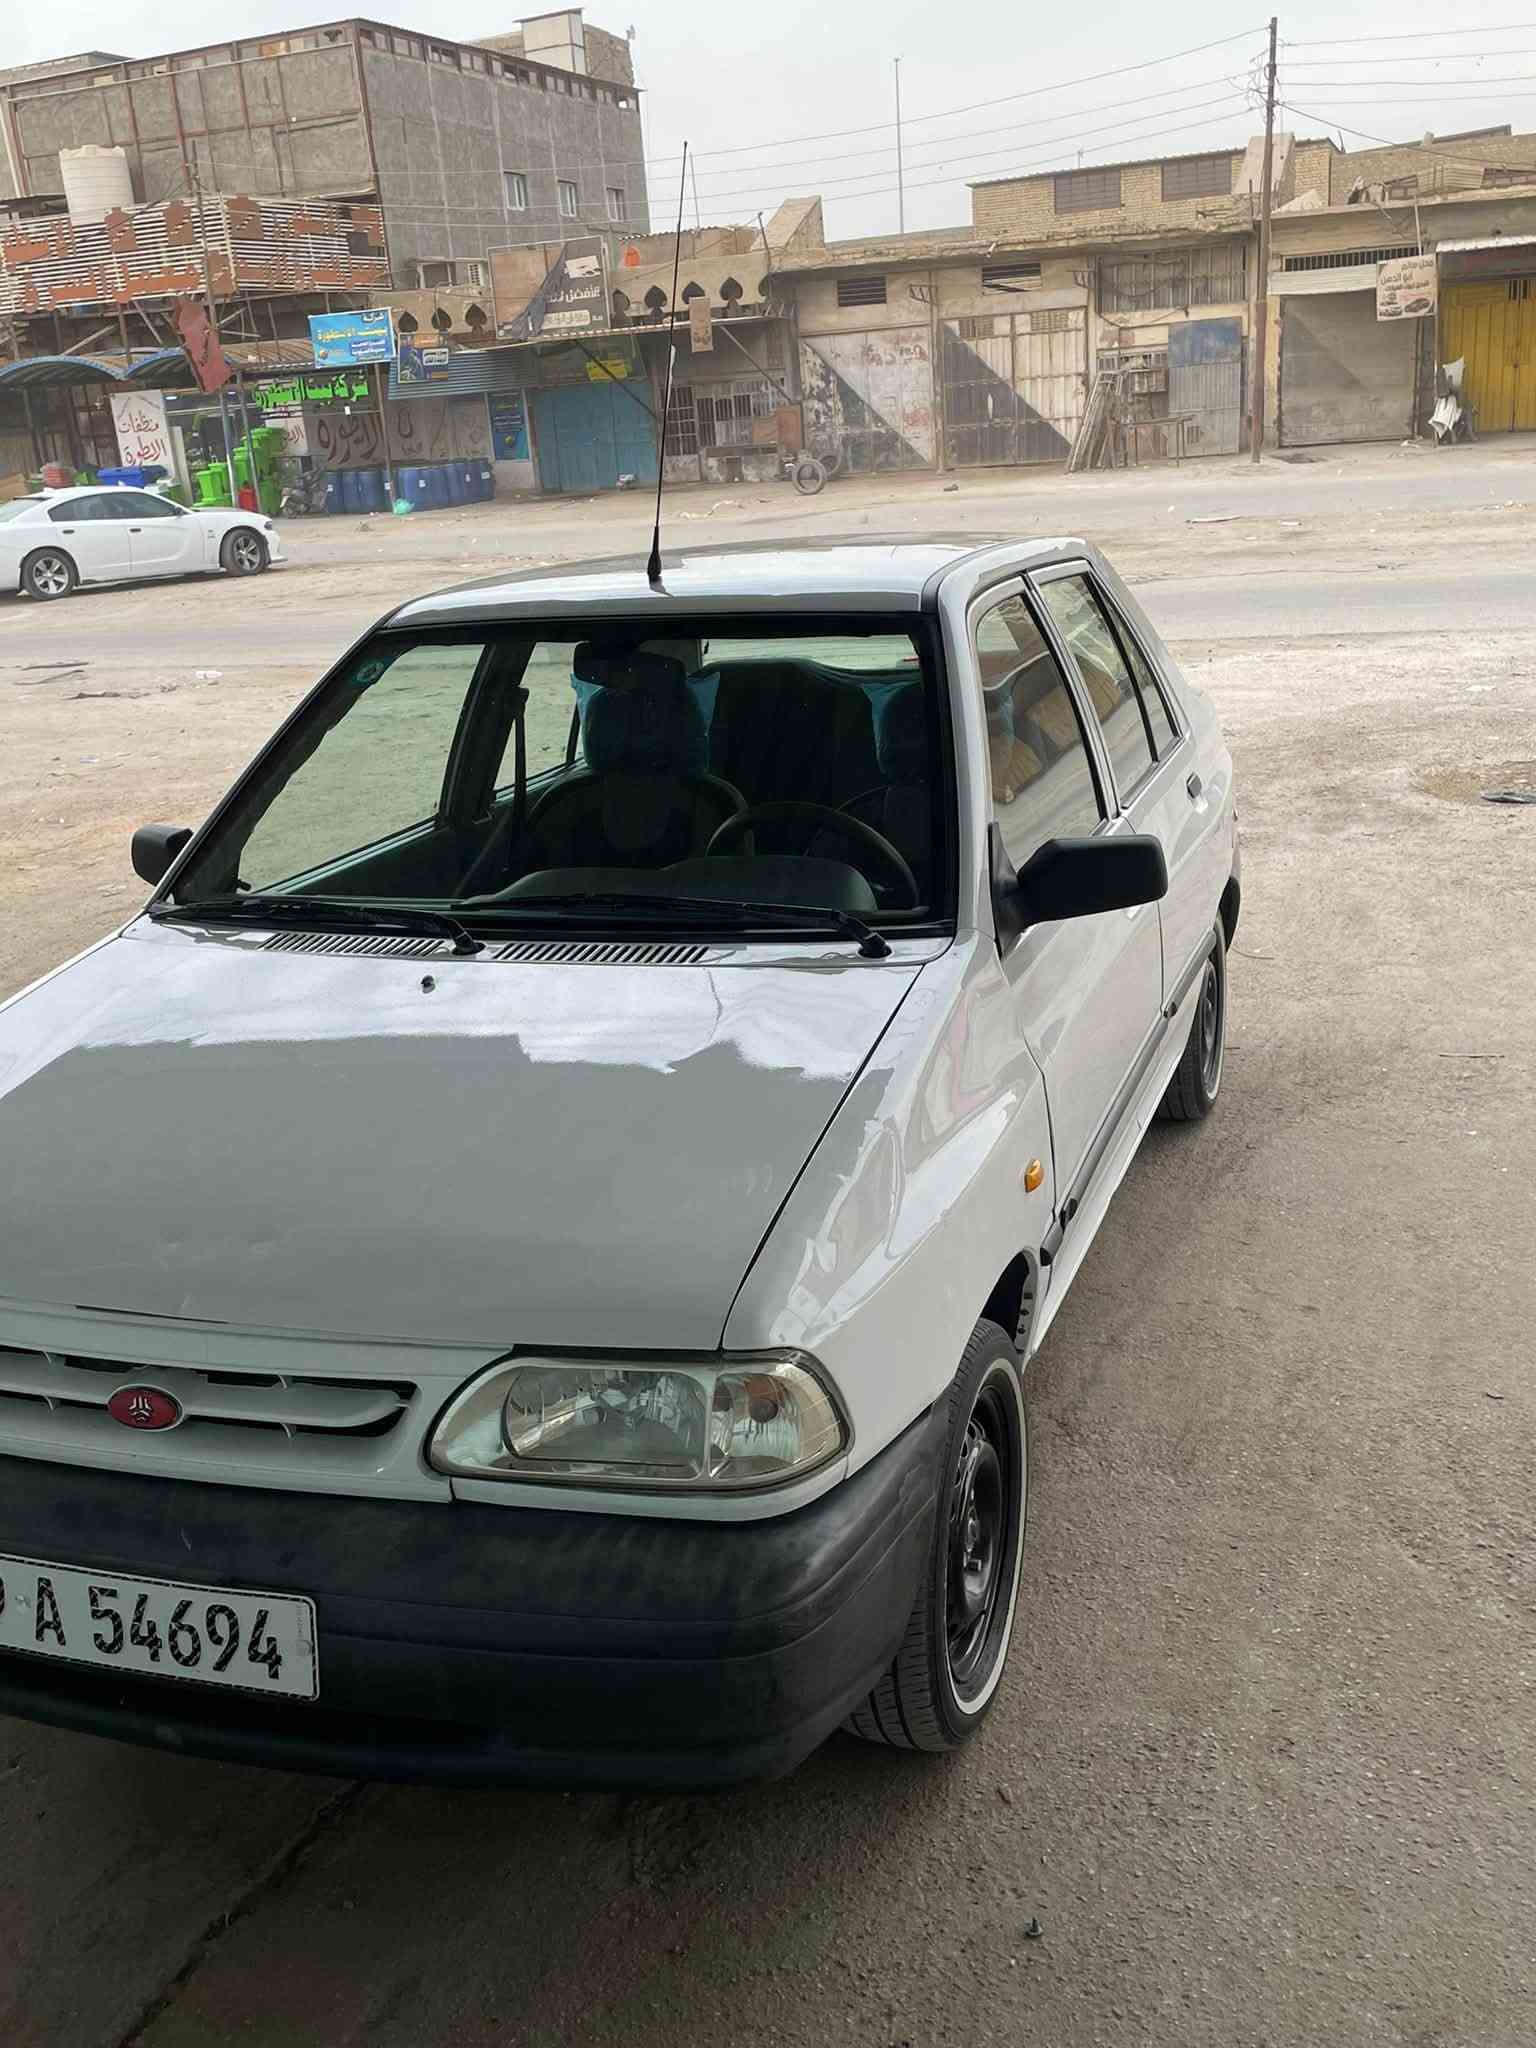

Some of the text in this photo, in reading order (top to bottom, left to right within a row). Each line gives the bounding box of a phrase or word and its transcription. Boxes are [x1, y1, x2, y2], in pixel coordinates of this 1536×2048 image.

[361, 311, 385, 323] شركة
[119, 409, 160, 433] منظفات
[35, 1576, 67, 1646] A
[88, 1584, 283, 1680] 54694
